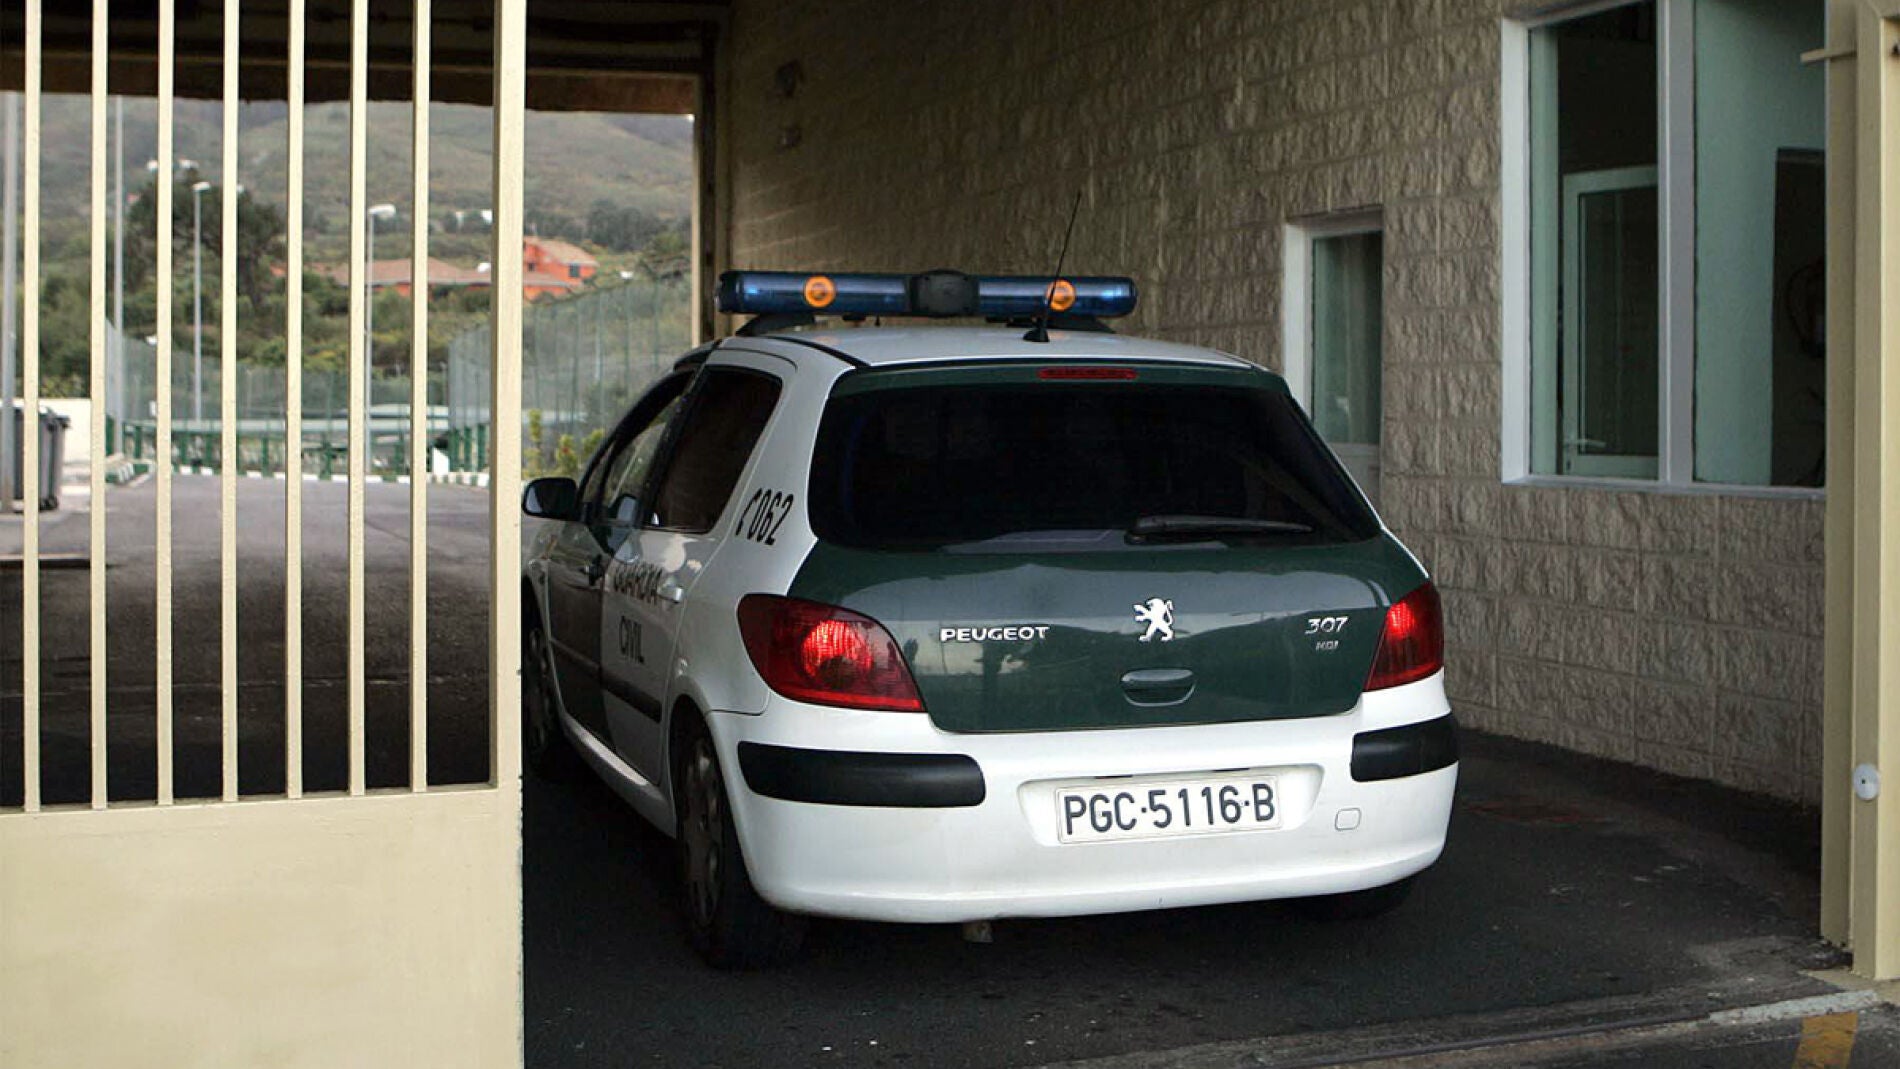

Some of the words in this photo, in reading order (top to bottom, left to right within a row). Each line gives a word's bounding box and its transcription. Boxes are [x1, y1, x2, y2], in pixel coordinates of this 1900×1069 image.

[747, 488, 794, 545] 062
[619, 615, 645, 664] CIVIL
[940, 626, 1049, 642] PEUGEOT
[1304, 615, 1349, 634] 307
